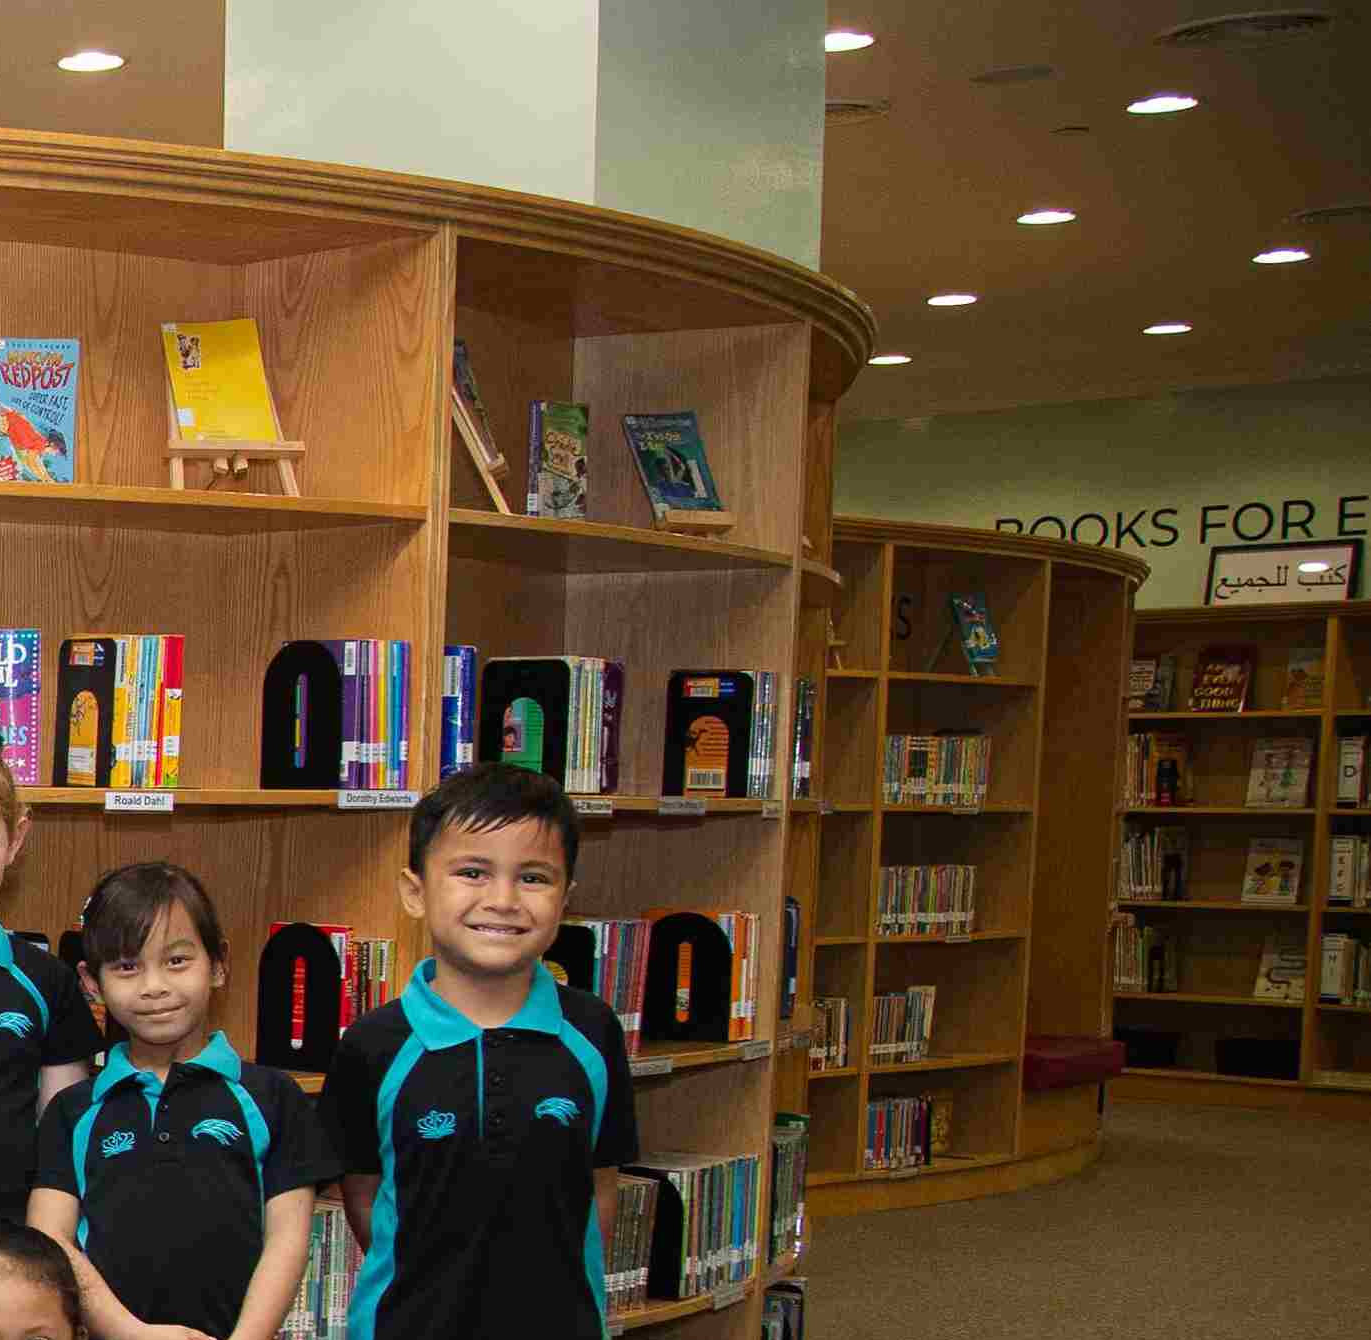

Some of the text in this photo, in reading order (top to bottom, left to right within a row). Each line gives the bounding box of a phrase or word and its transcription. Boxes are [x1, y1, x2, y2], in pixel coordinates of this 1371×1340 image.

[1199, 499, 1317, 545] FOR
[1214, 564, 1348, 599] كتب للجميع
[114, 794, 165, 806] Roald Dahl
[346, 793, 411, 804] Dorothy Edwards
